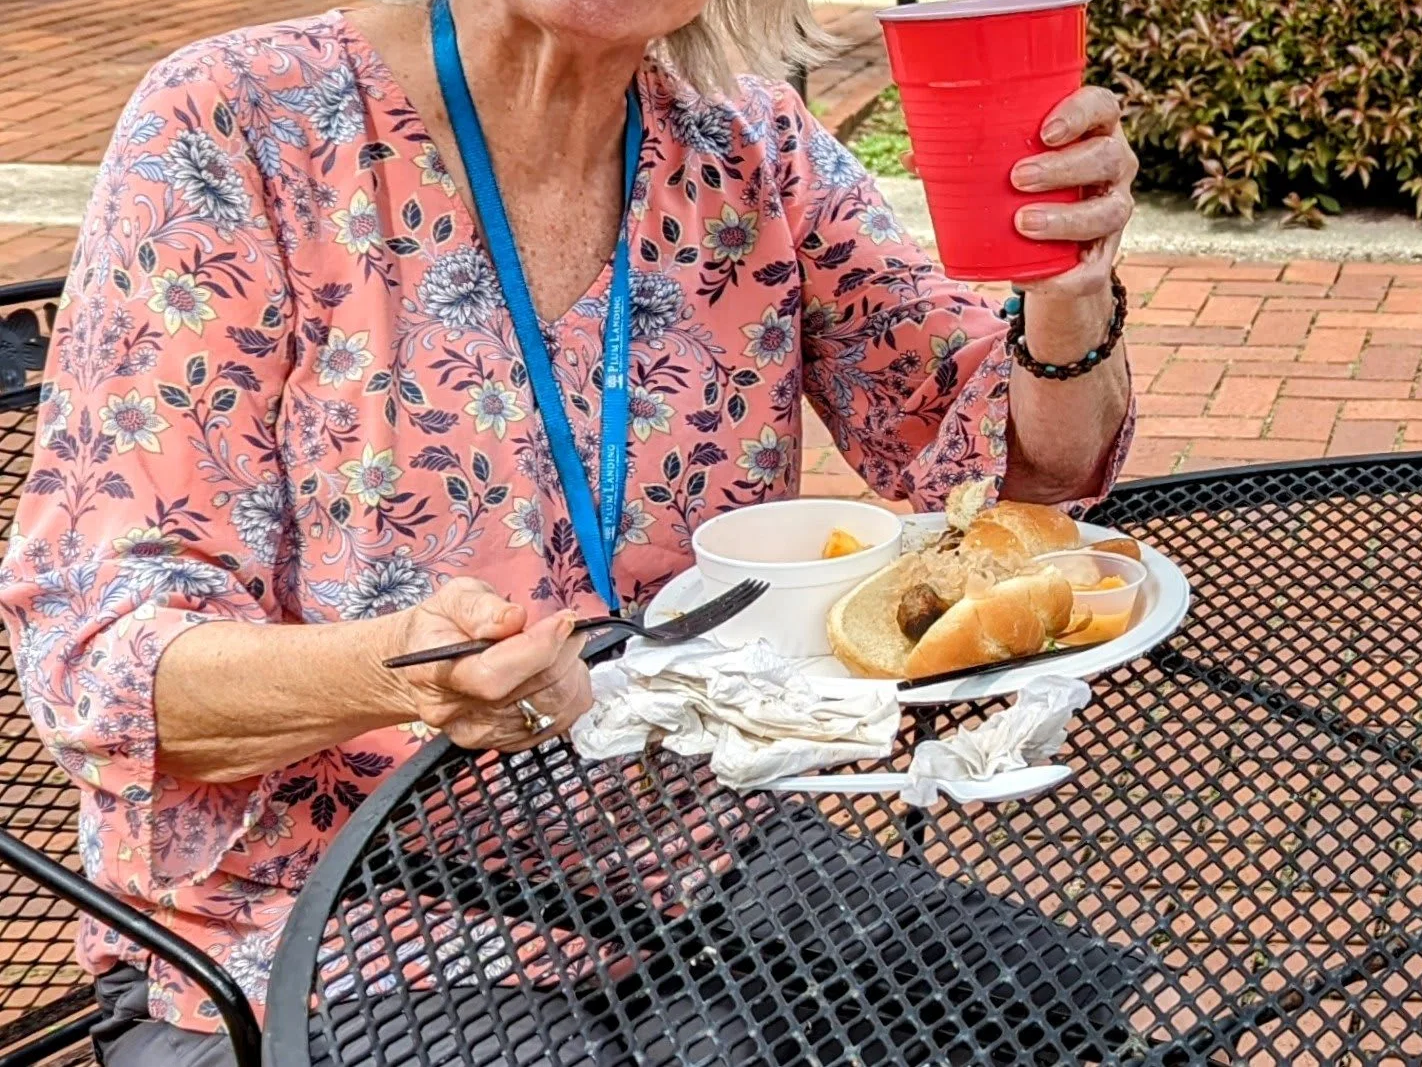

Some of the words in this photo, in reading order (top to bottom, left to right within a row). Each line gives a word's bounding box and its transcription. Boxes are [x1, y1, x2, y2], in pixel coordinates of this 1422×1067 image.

[609, 295, 622, 342] LANDING
[606, 345, 620, 373] PLUM
[603, 443, 616, 493] LANDING
